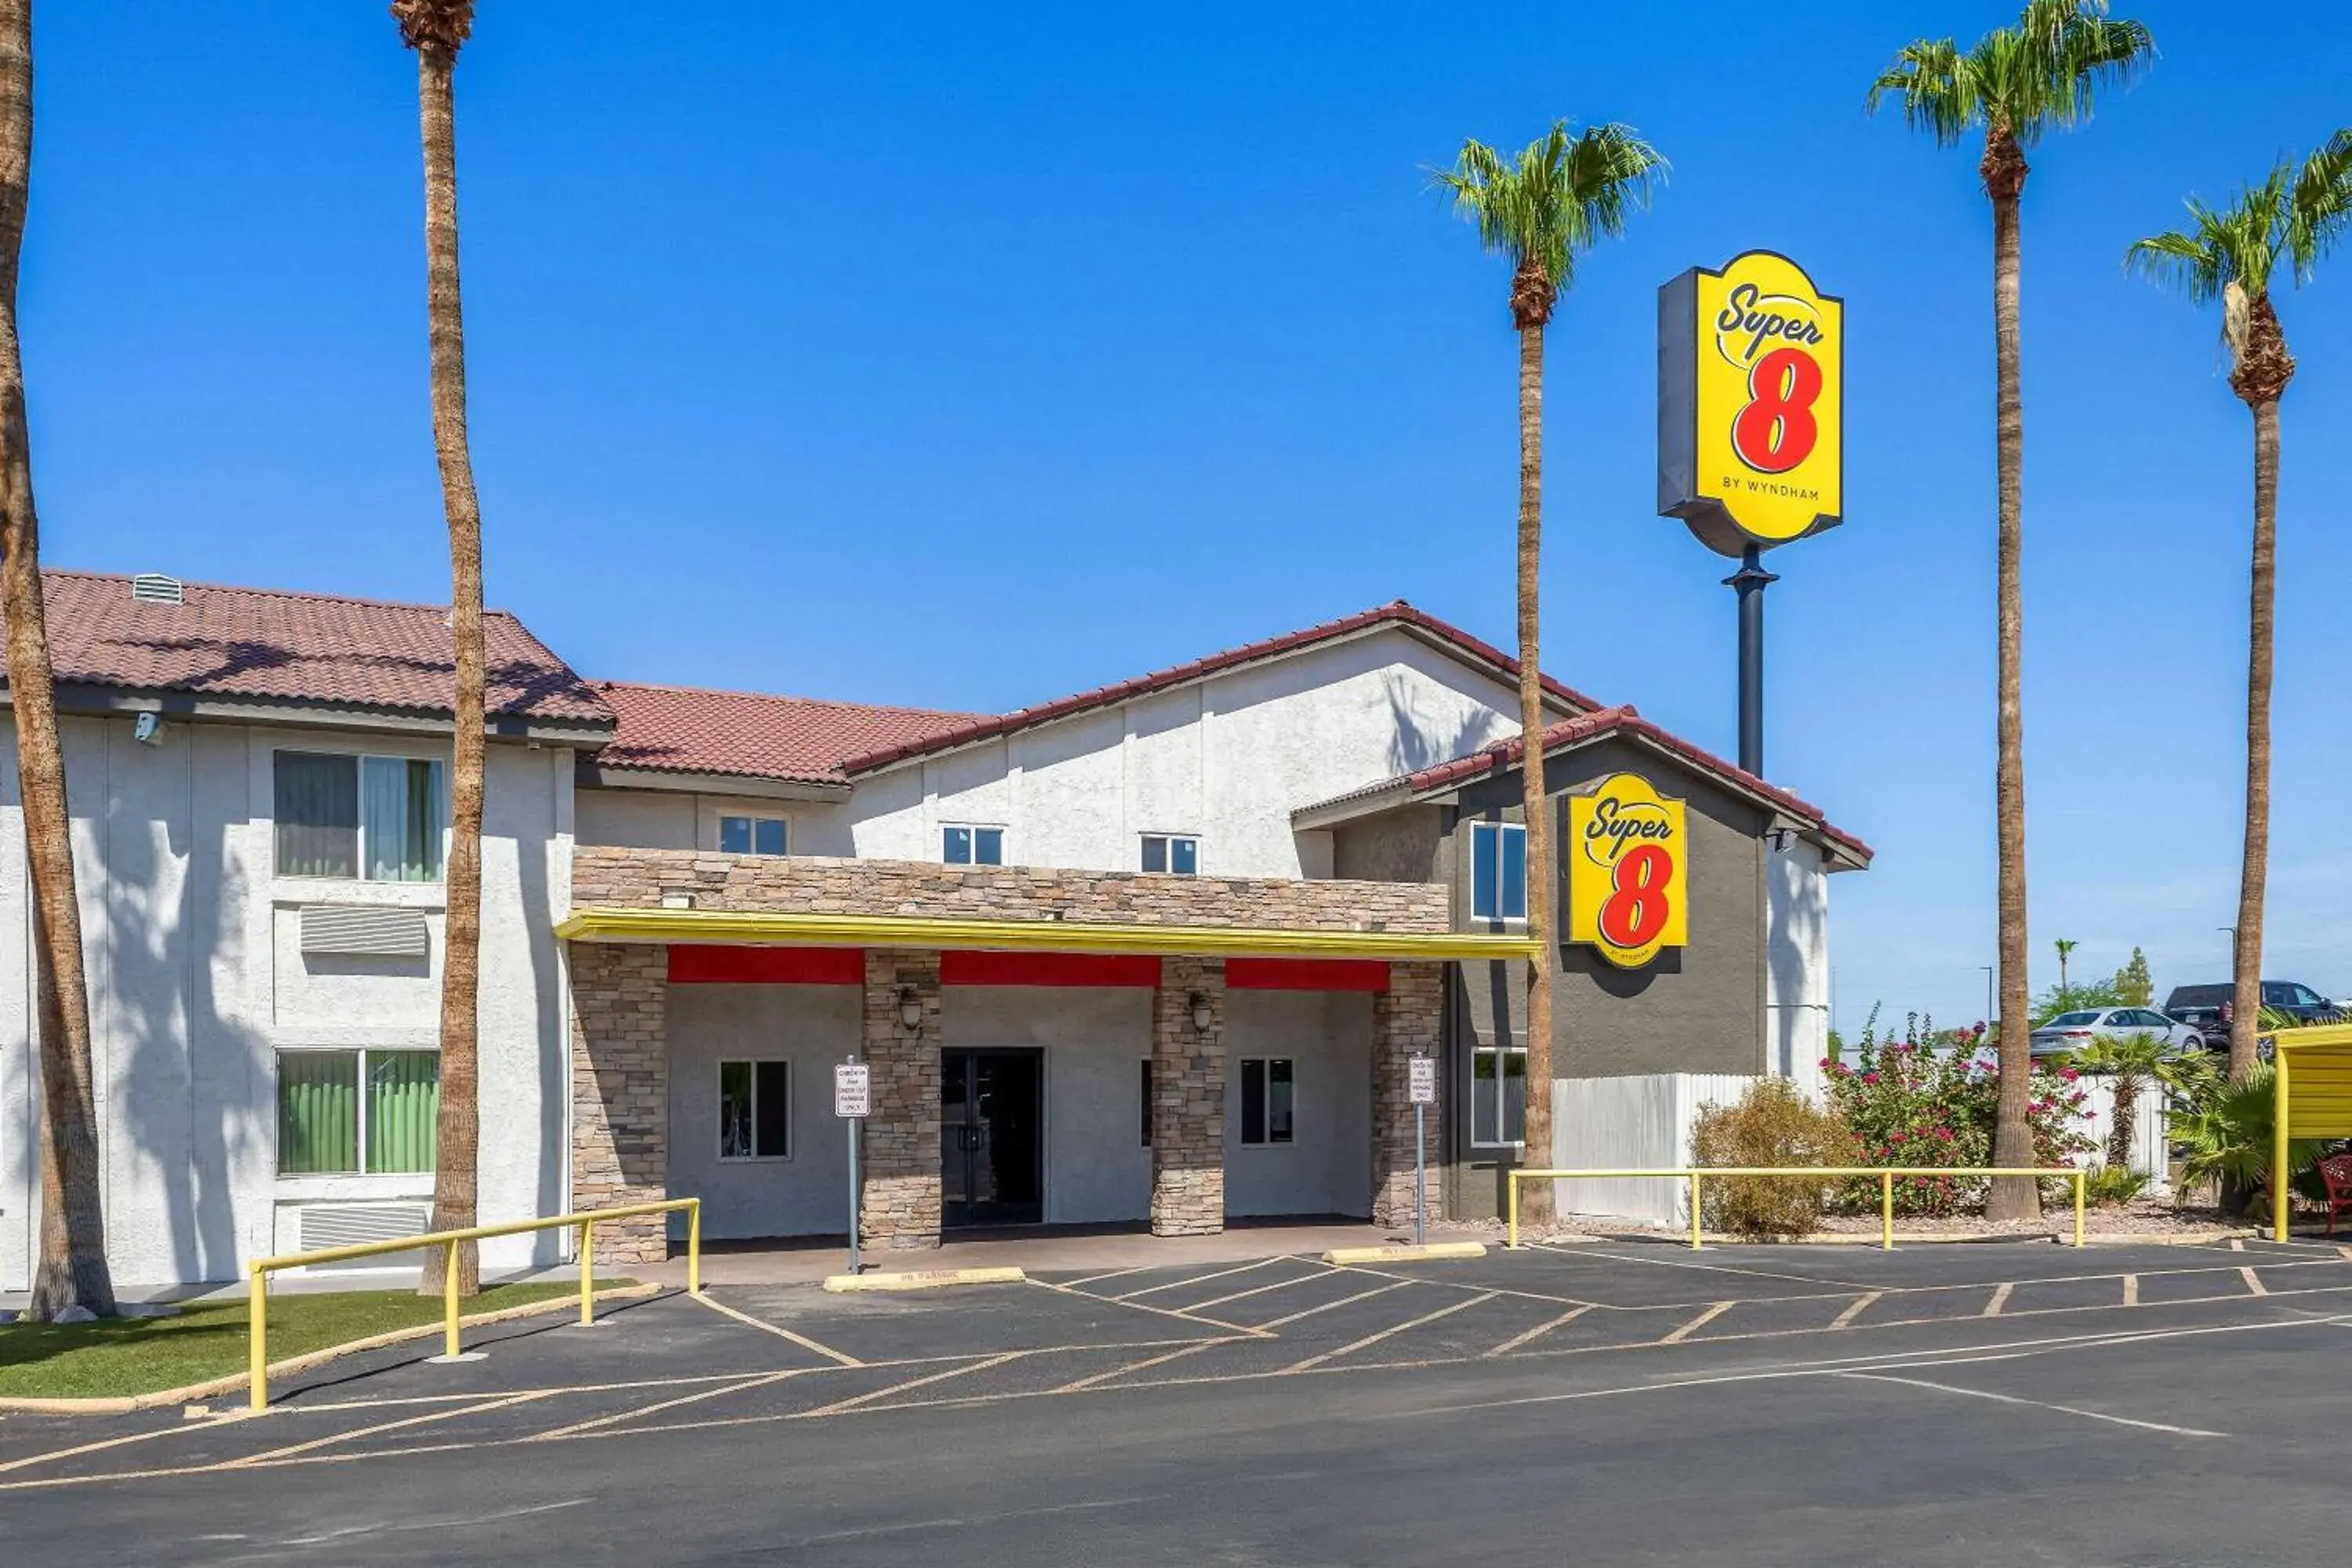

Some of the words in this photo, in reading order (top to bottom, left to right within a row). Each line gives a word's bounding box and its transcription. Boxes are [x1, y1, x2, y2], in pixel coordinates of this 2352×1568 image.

[1718, 283, 1824, 361] Super
[1730, 347, 1823, 475] 8
[1722, 476, 1740, 488] BY
[1748, 480, 1819, 501] WYNDHAM
[1586, 797, 1673, 860] Super
[1597, 844, 1673, 949] 8
